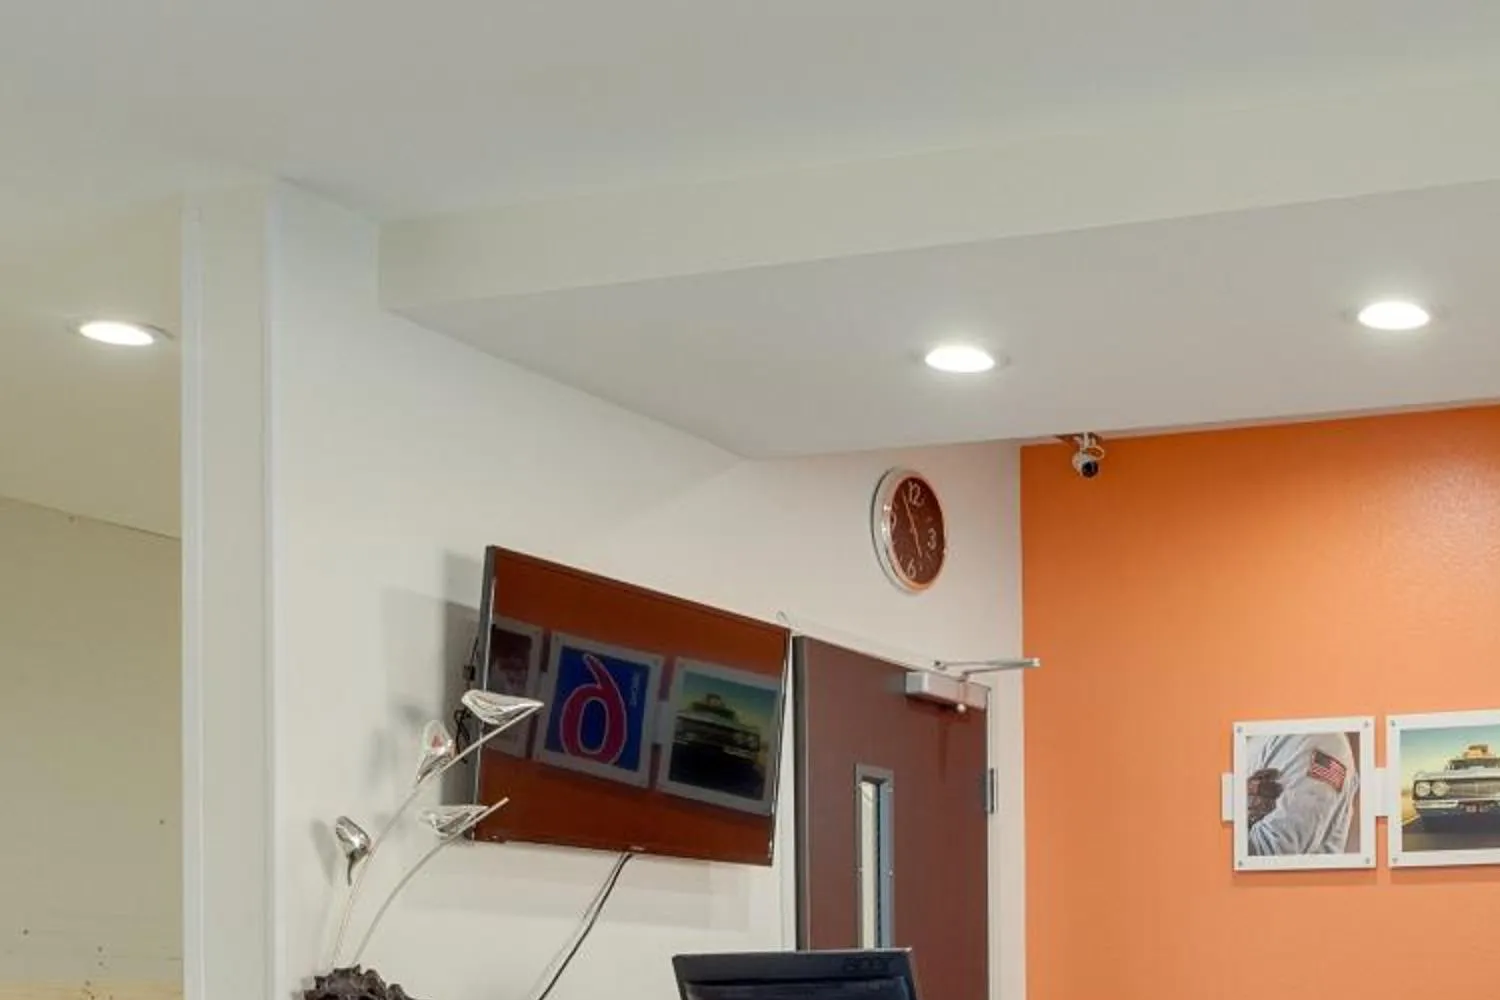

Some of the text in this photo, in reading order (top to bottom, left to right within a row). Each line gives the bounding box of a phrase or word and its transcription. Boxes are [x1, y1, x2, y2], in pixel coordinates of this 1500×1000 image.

[908, 480, 925, 507] 12
[927, 527, 938, 551] 3
[906, 558, 917, 579] 6
